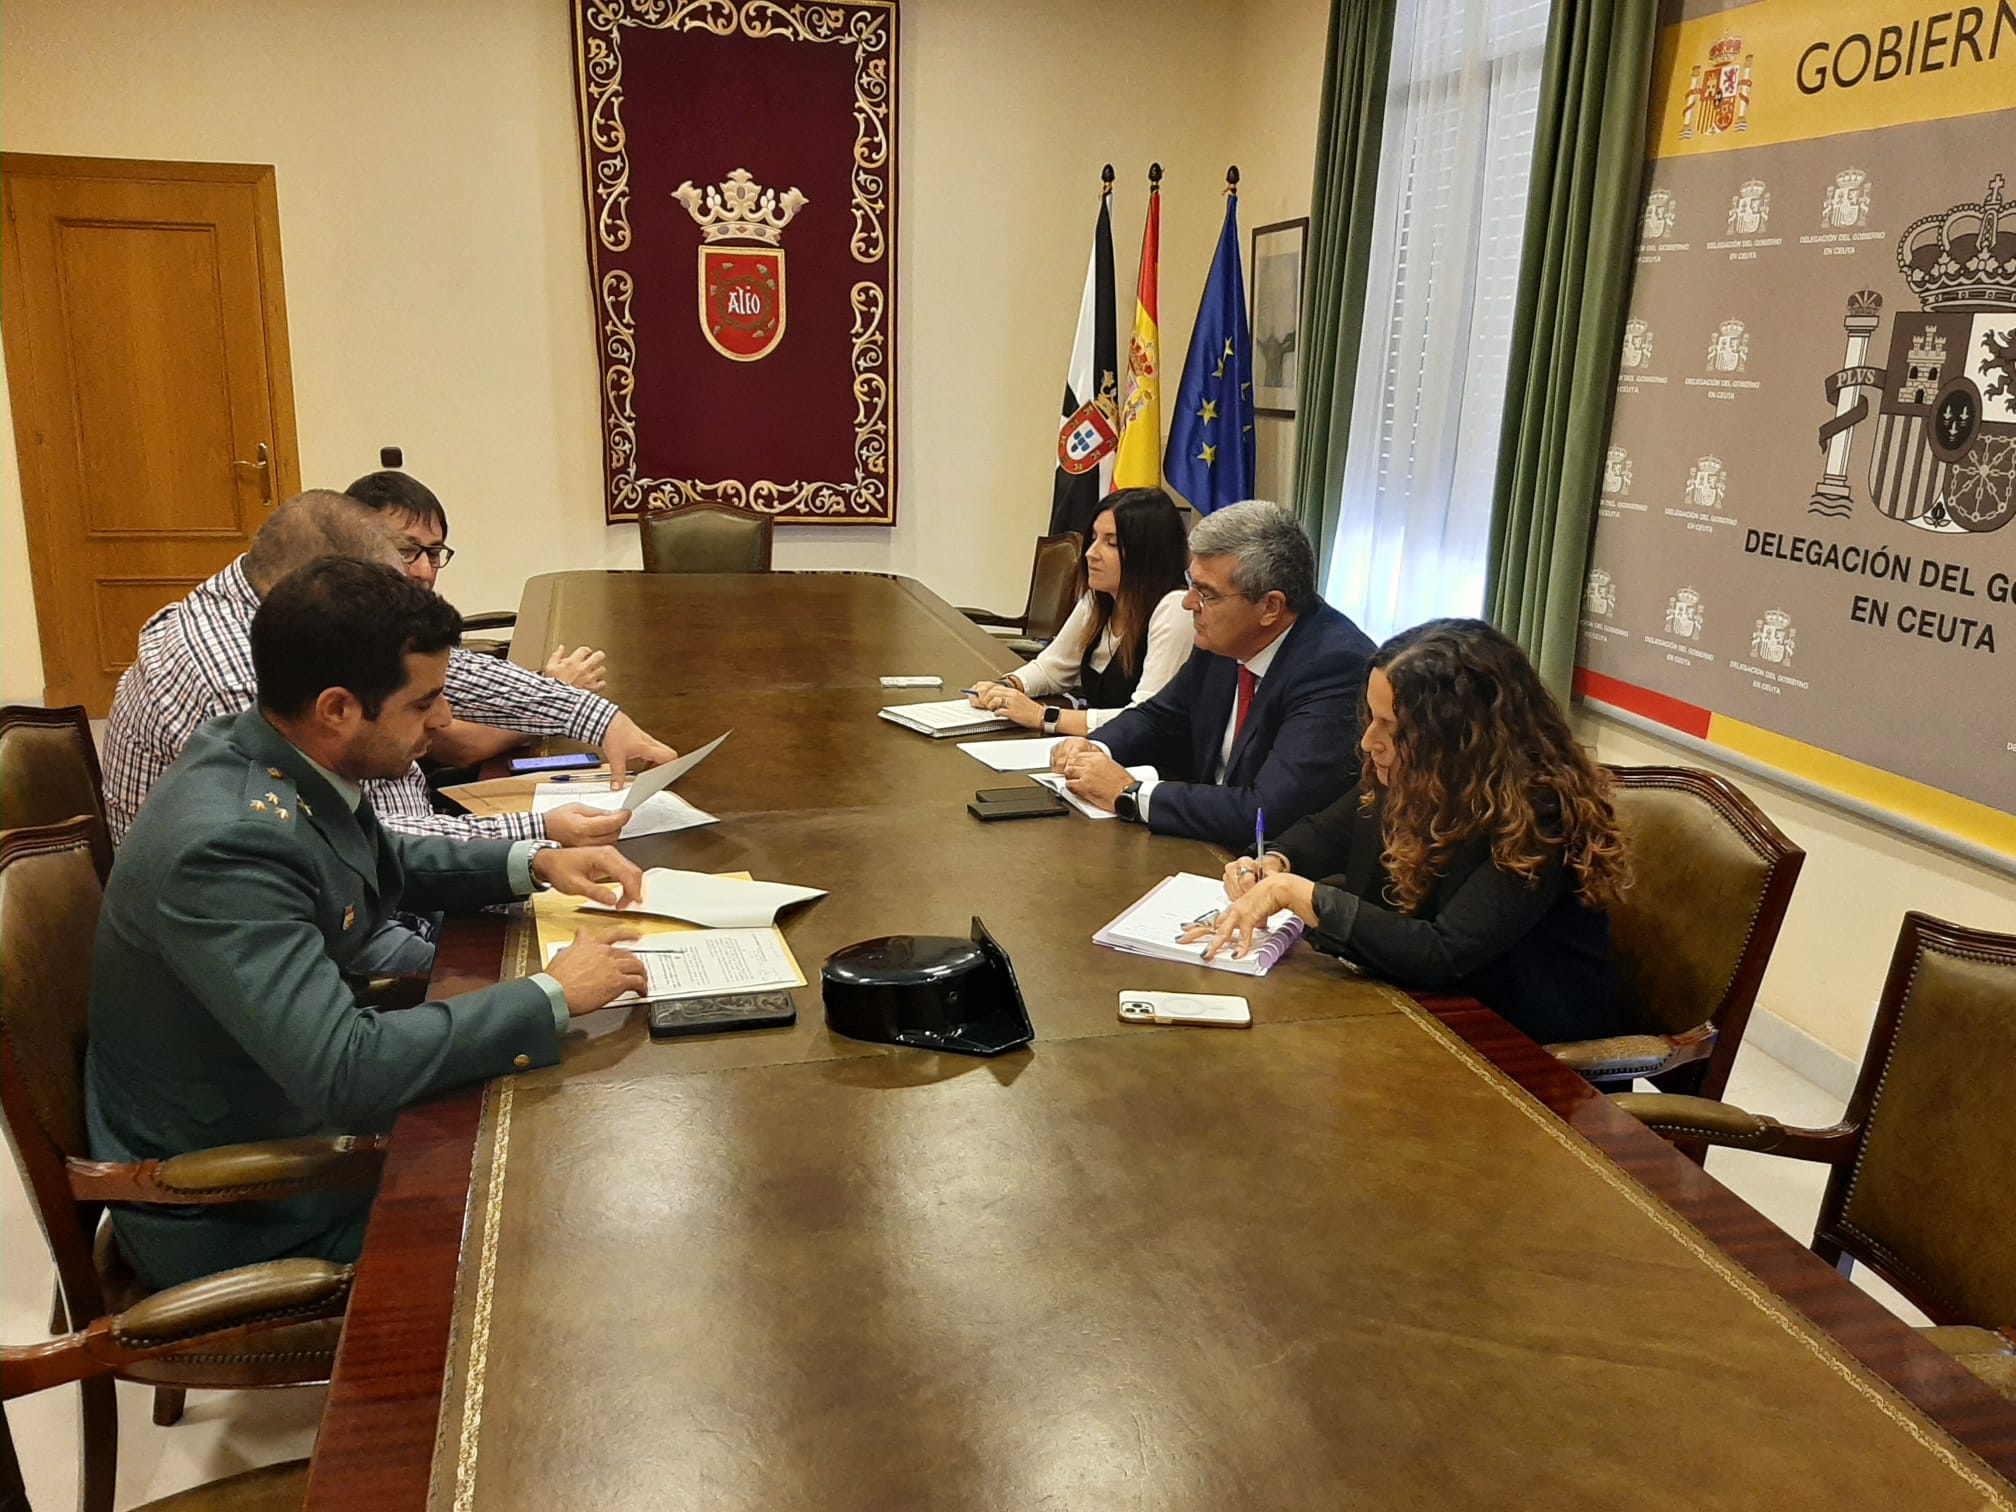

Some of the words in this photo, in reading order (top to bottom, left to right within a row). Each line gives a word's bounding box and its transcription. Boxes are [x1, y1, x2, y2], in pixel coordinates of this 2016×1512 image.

[1836, 368, 1876, 388] PLVS
[1744, 528, 1912, 583] DELEGACIÓN
[1919, 559, 1975, 597] DEL
[1850, 595, 1889, 627] EN
[1896, 605, 1996, 654] CEUTA
